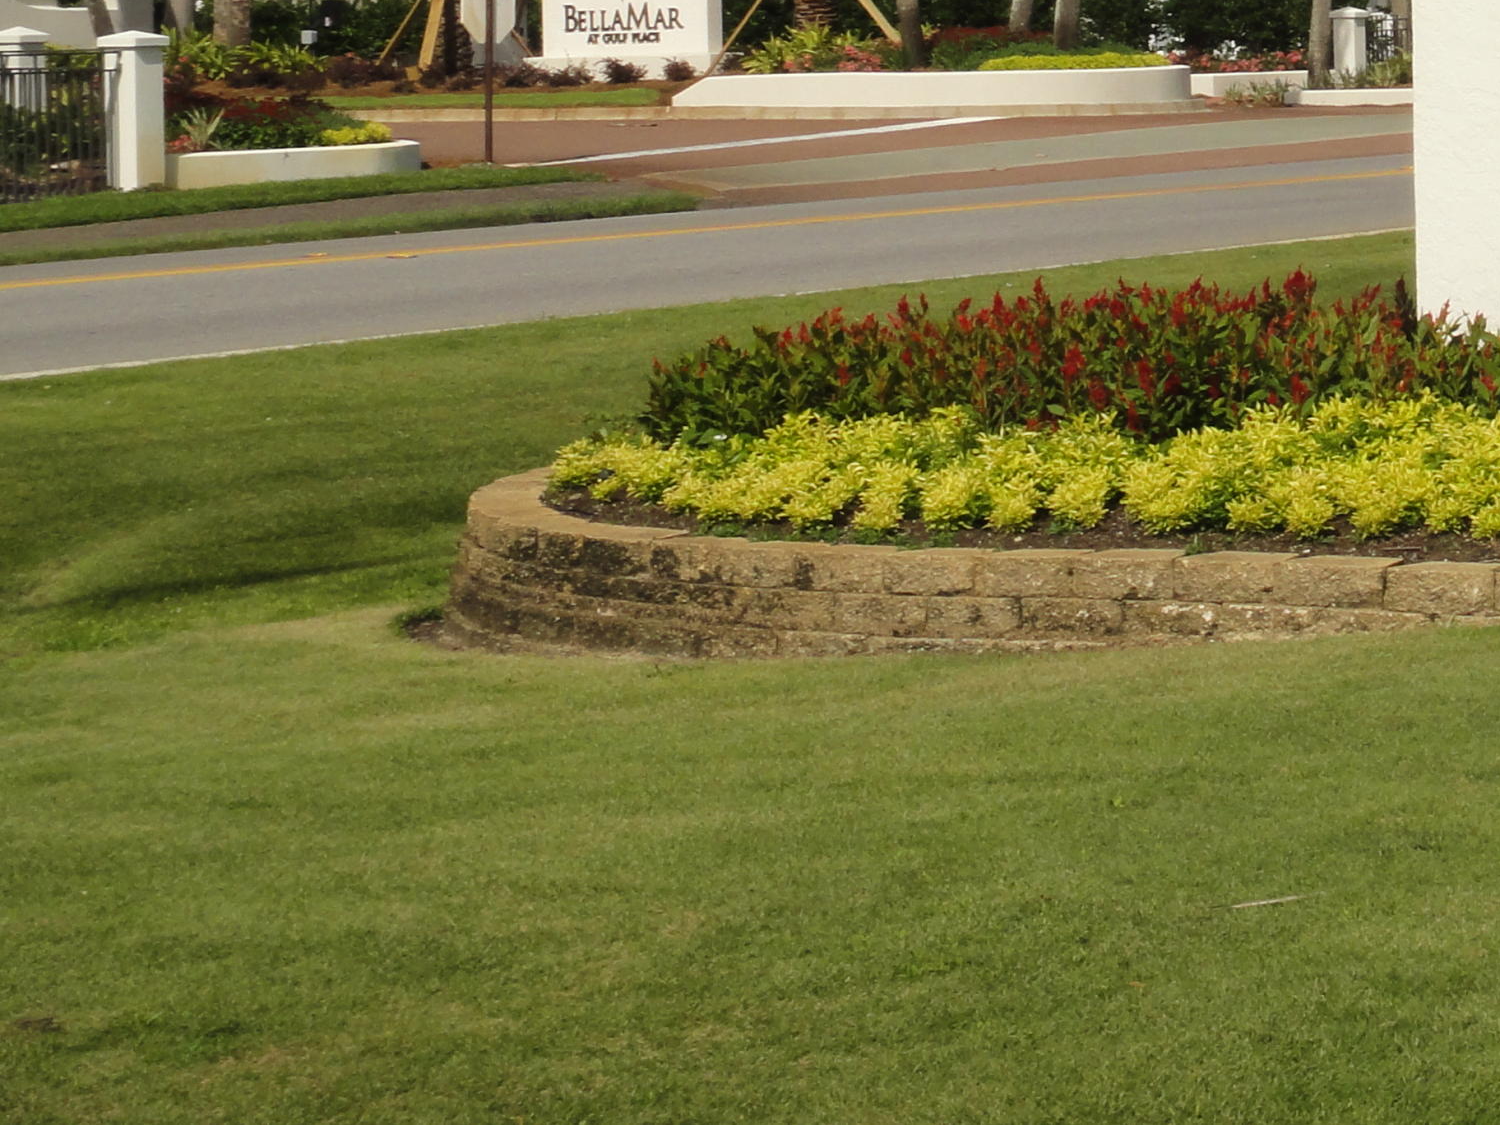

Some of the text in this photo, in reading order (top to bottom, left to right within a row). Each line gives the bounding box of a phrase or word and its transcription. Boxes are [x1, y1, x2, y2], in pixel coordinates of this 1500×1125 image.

[588, 32, 660, 44] AT GULF PLACE
